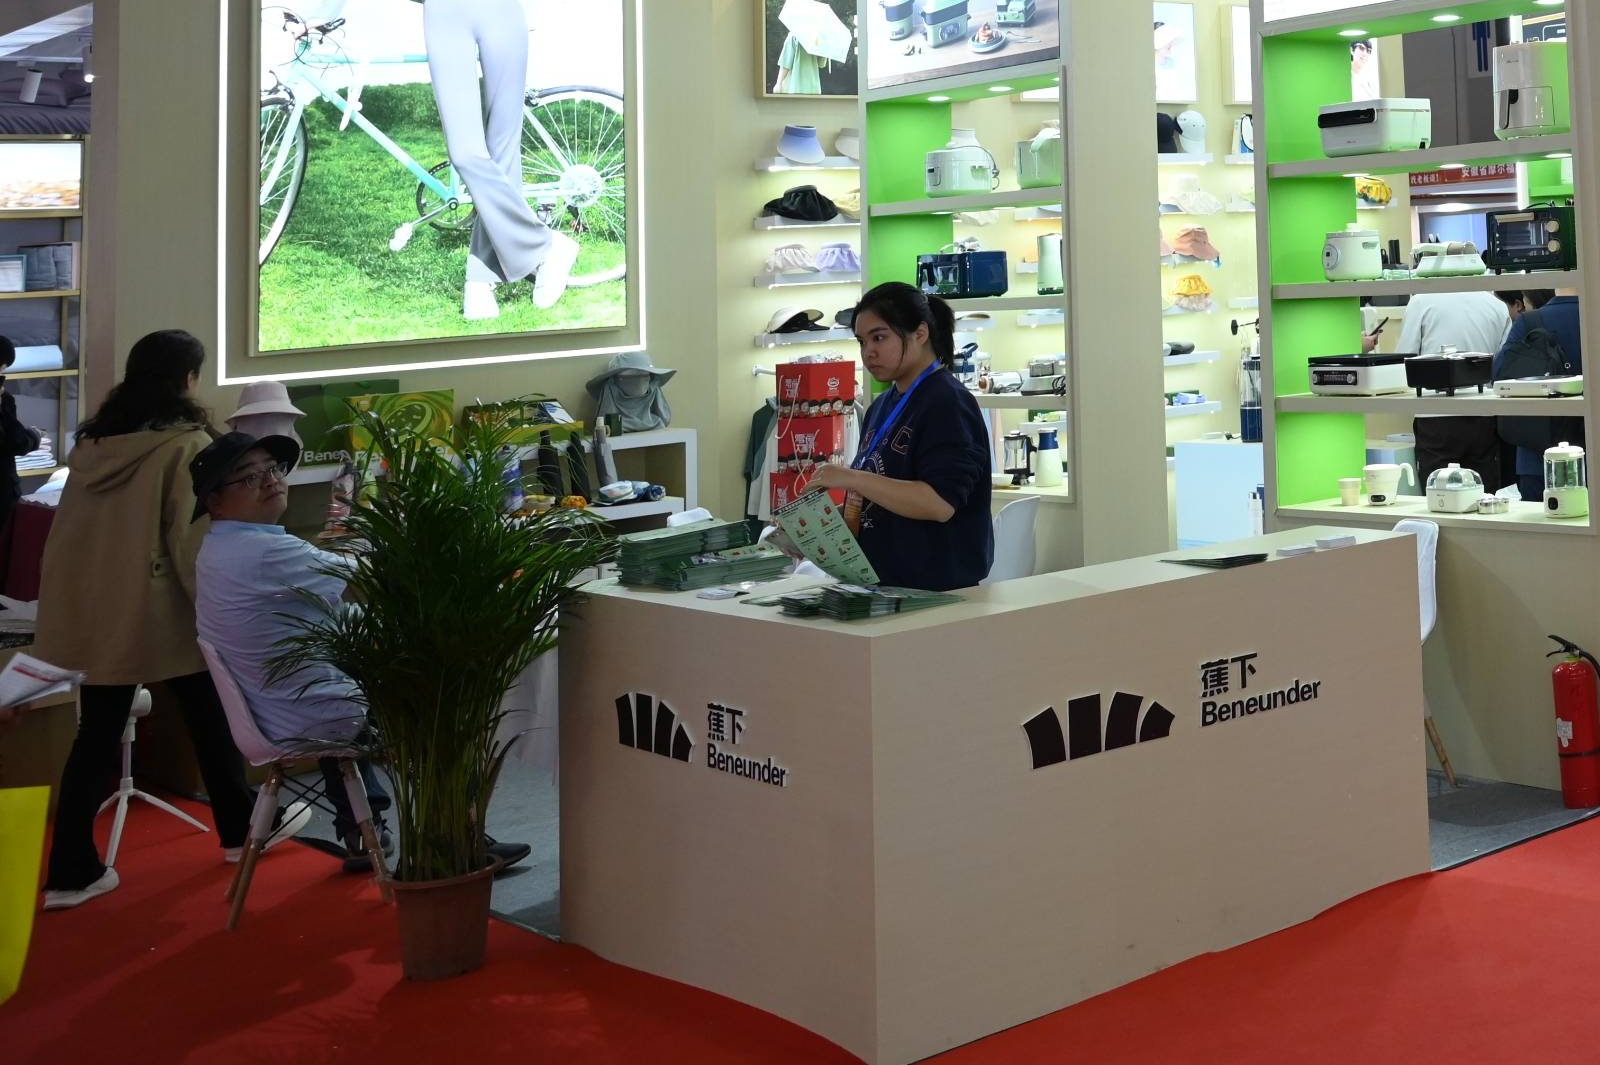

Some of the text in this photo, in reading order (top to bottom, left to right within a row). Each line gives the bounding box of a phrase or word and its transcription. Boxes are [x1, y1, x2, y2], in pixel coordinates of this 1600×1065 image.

[304, 449, 347, 463] Bene
[1200, 653, 1259, 699] 蕉下
[706, 702, 746, 745] 蕉下
[1200, 678, 1322, 728] Beneunder
[706, 743, 788, 788] Beneunder
